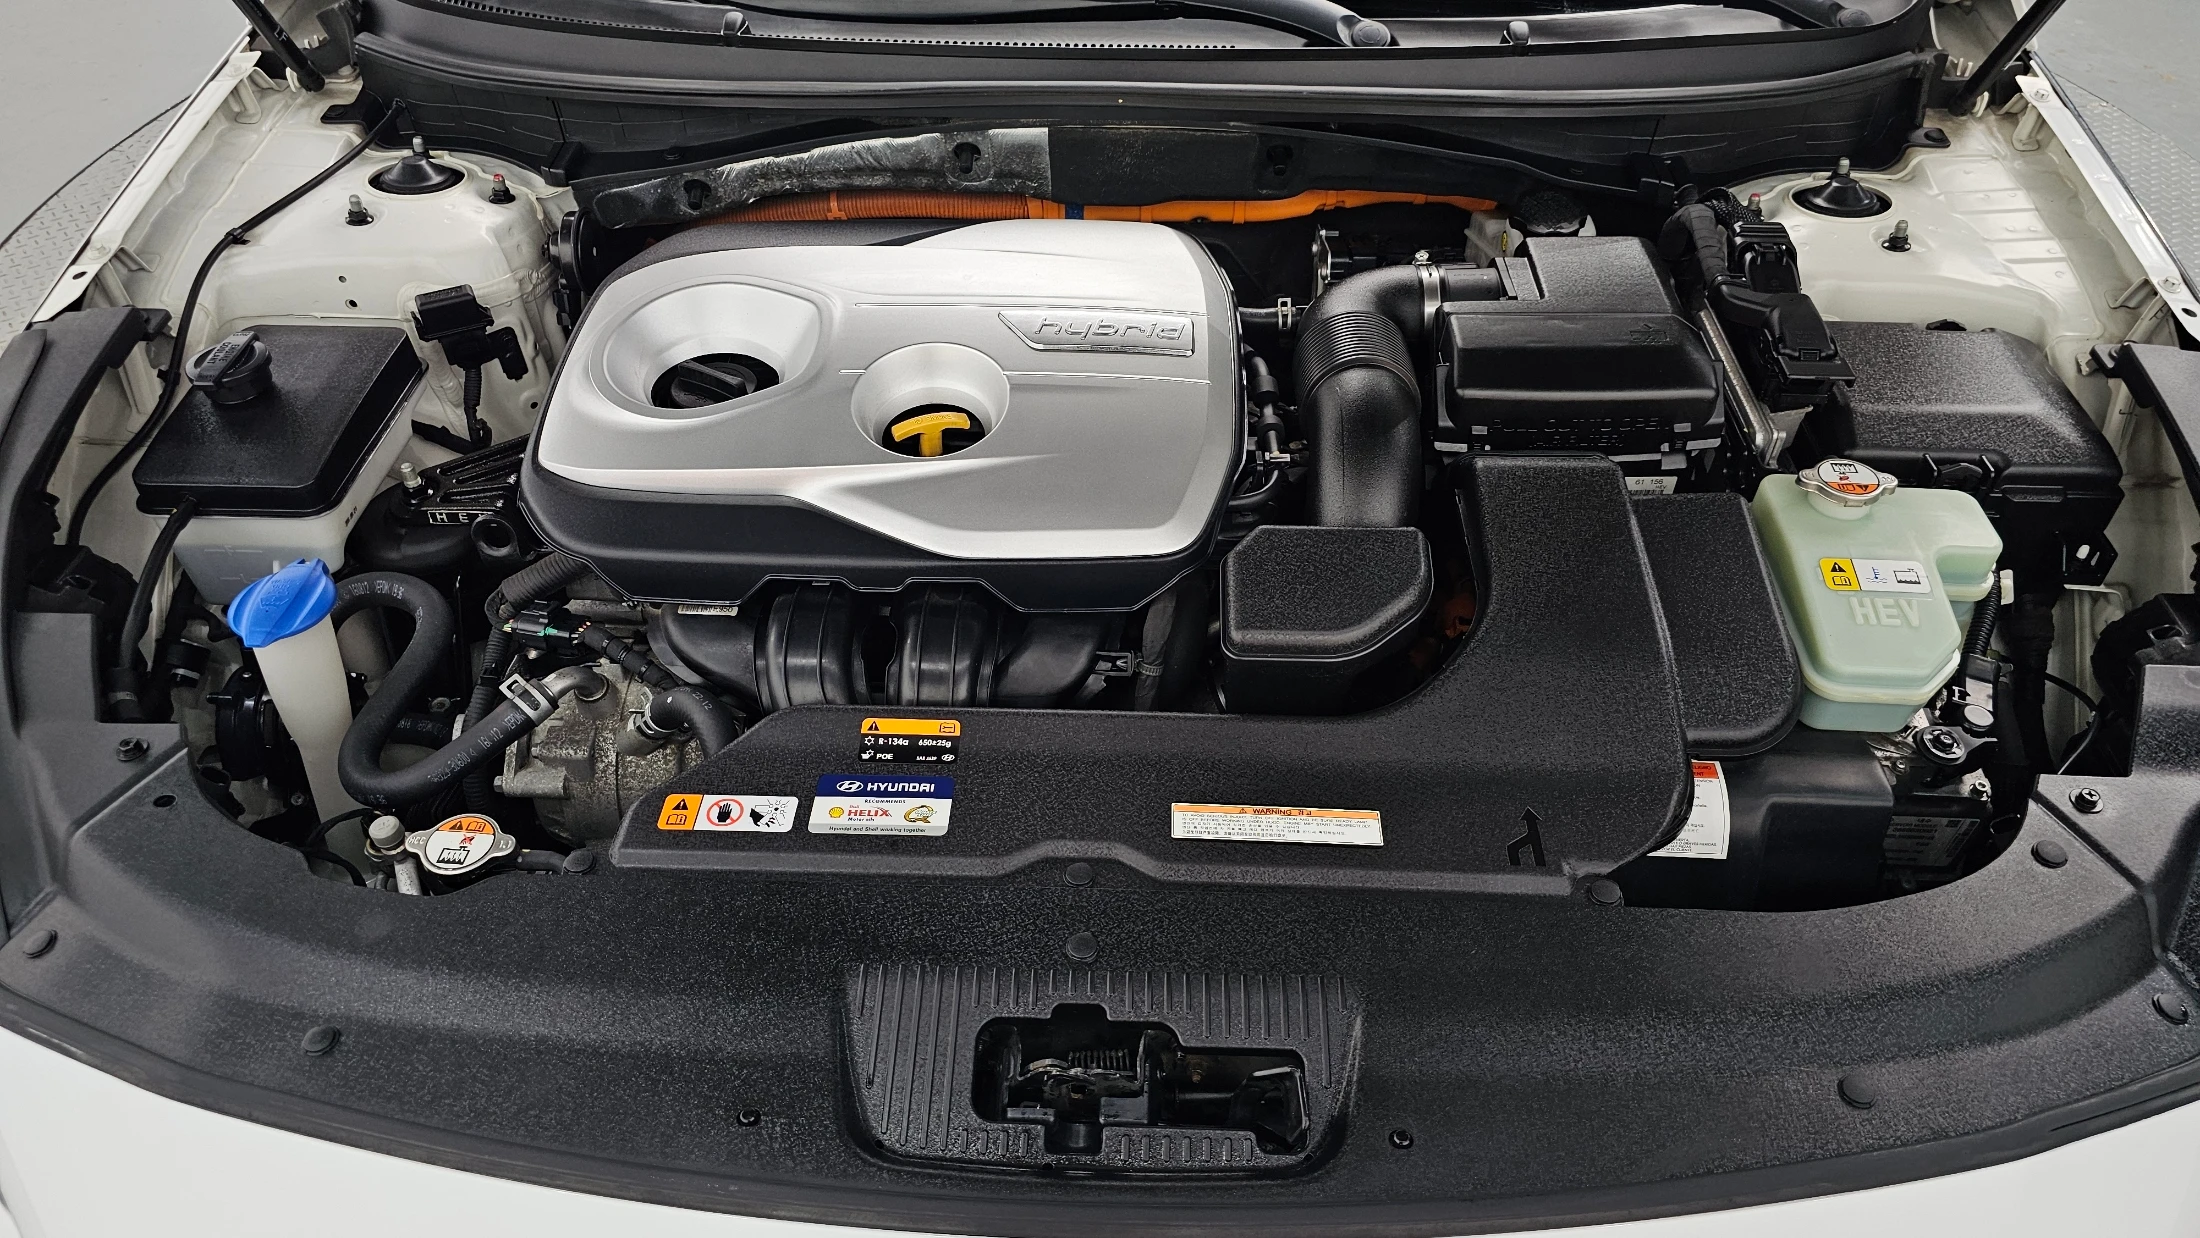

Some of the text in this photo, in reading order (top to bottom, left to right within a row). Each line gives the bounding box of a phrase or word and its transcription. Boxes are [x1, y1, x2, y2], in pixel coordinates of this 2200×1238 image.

[1035, 317, 1187, 341] hybrid
[1849, 596, 1921, 627] HEV
[878, 738, 952, 749] R-134a 650±25g
[867, 783, 935, 793] HYUNDAI
[848, 808, 890, 817] HELIX
[407, 836, 427, 845] HCC
